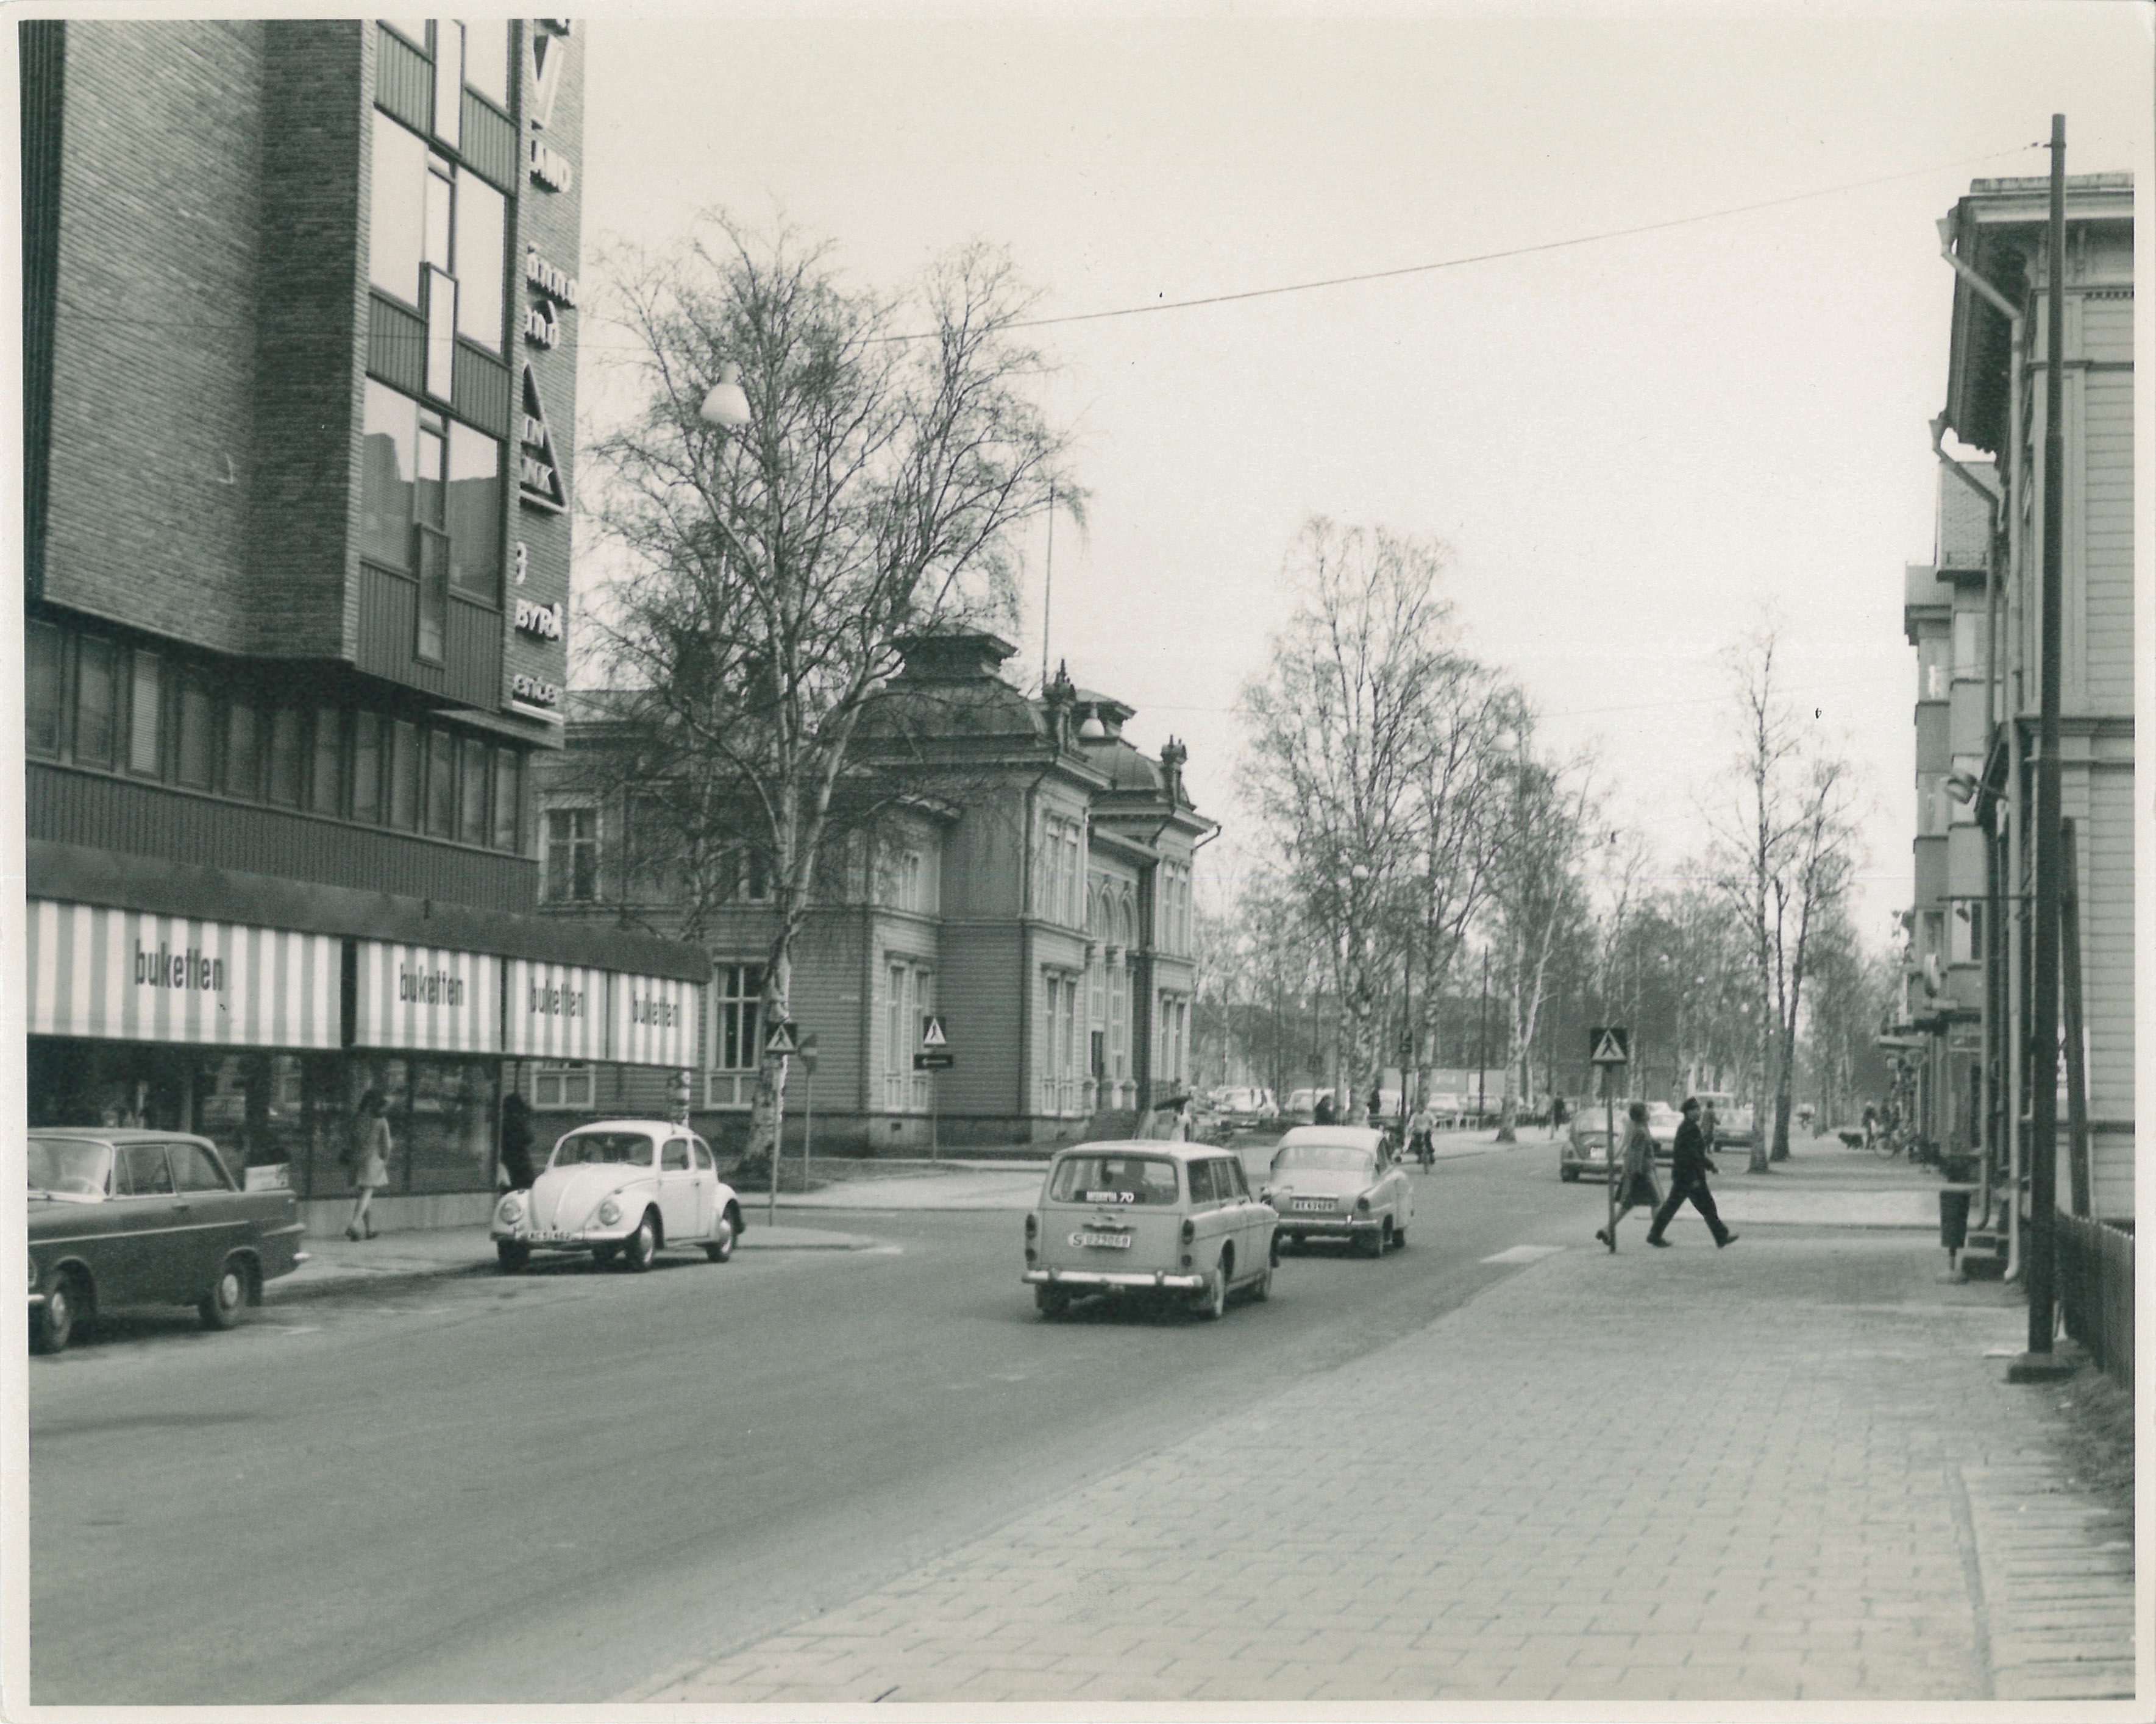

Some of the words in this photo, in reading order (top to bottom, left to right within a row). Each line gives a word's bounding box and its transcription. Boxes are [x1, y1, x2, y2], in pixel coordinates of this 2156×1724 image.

[135, 938, 223, 991] buketten
[399, 963, 464, 1007] buketten
[530, 977, 584, 1018] buketten
[632, 990, 678, 1028] buketten
